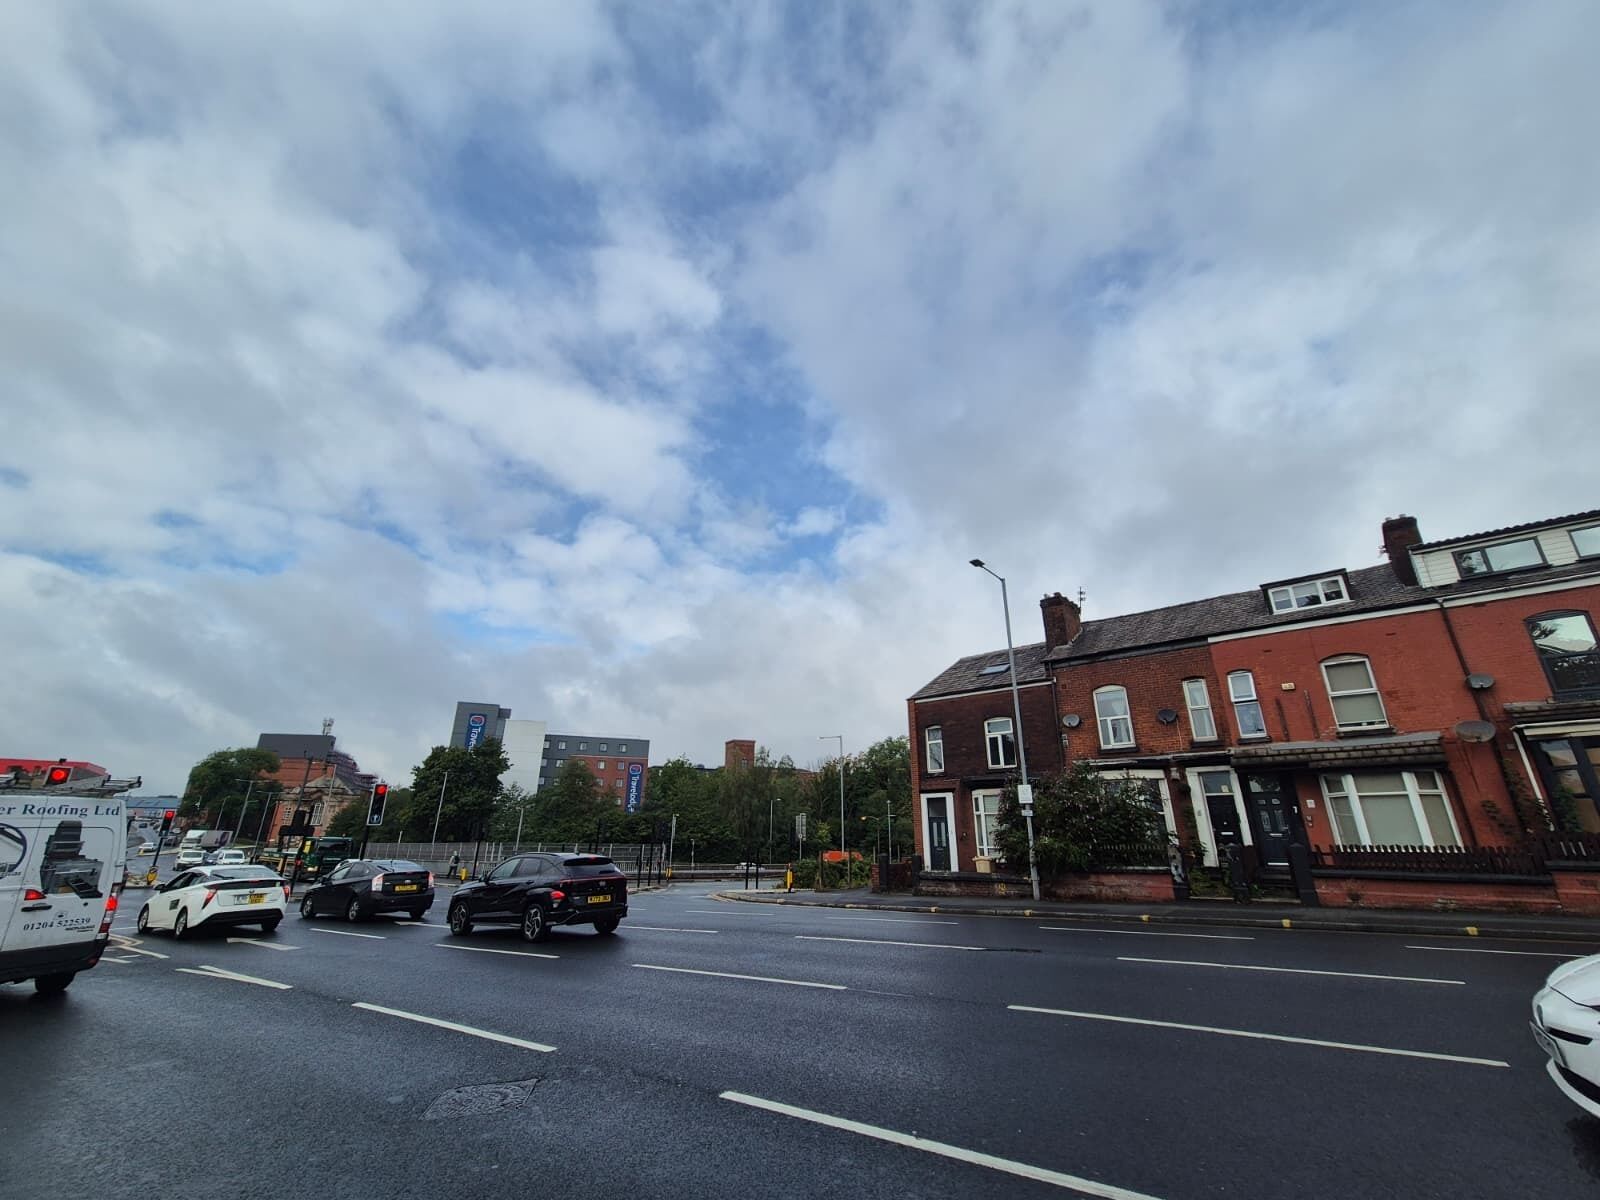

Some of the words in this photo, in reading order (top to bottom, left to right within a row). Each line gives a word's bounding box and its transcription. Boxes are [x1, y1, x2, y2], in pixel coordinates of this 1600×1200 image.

[22, 804, 88, 818] Roofing
[94, 805, 120, 816] Ltd
[23, 921, 54, 931] 01204
